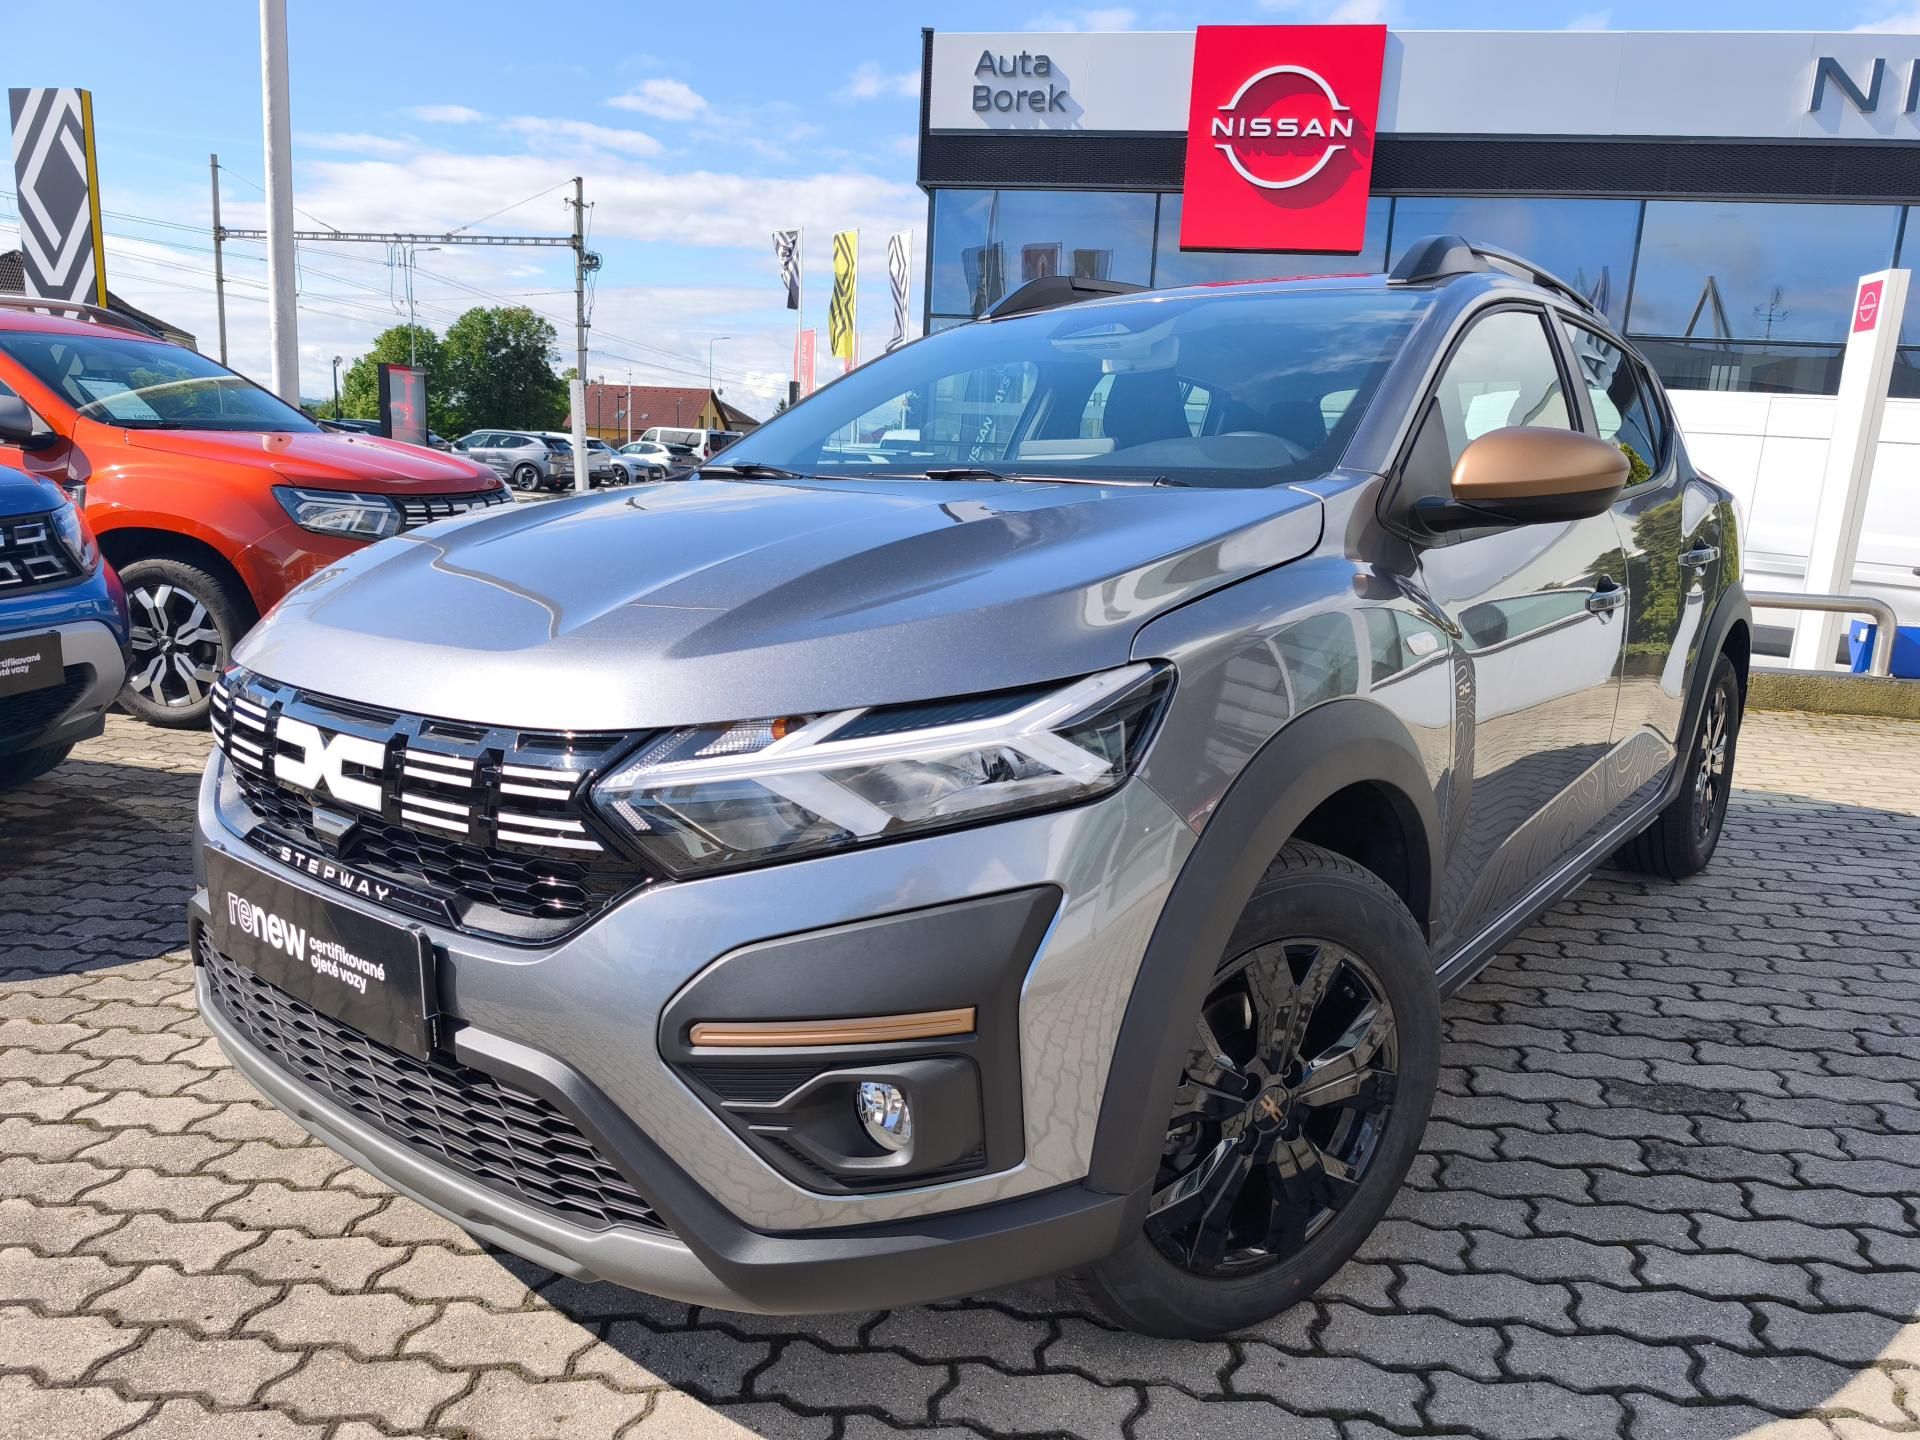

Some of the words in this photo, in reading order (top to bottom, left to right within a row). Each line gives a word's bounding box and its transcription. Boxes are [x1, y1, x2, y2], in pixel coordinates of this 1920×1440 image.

[974, 50, 1051, 78] Auta
[972, 84, 1067, 113] Borek
[1211, 117, 1353, 138] NISSAN
[280, 846, 389, 901] STEPWAY
[227, 891, 306, 962] renew
[309, 936, 386, 982] certifikované
[310, 953, 339, 979] ojeté
[339, 967, 367, 995] vozy
